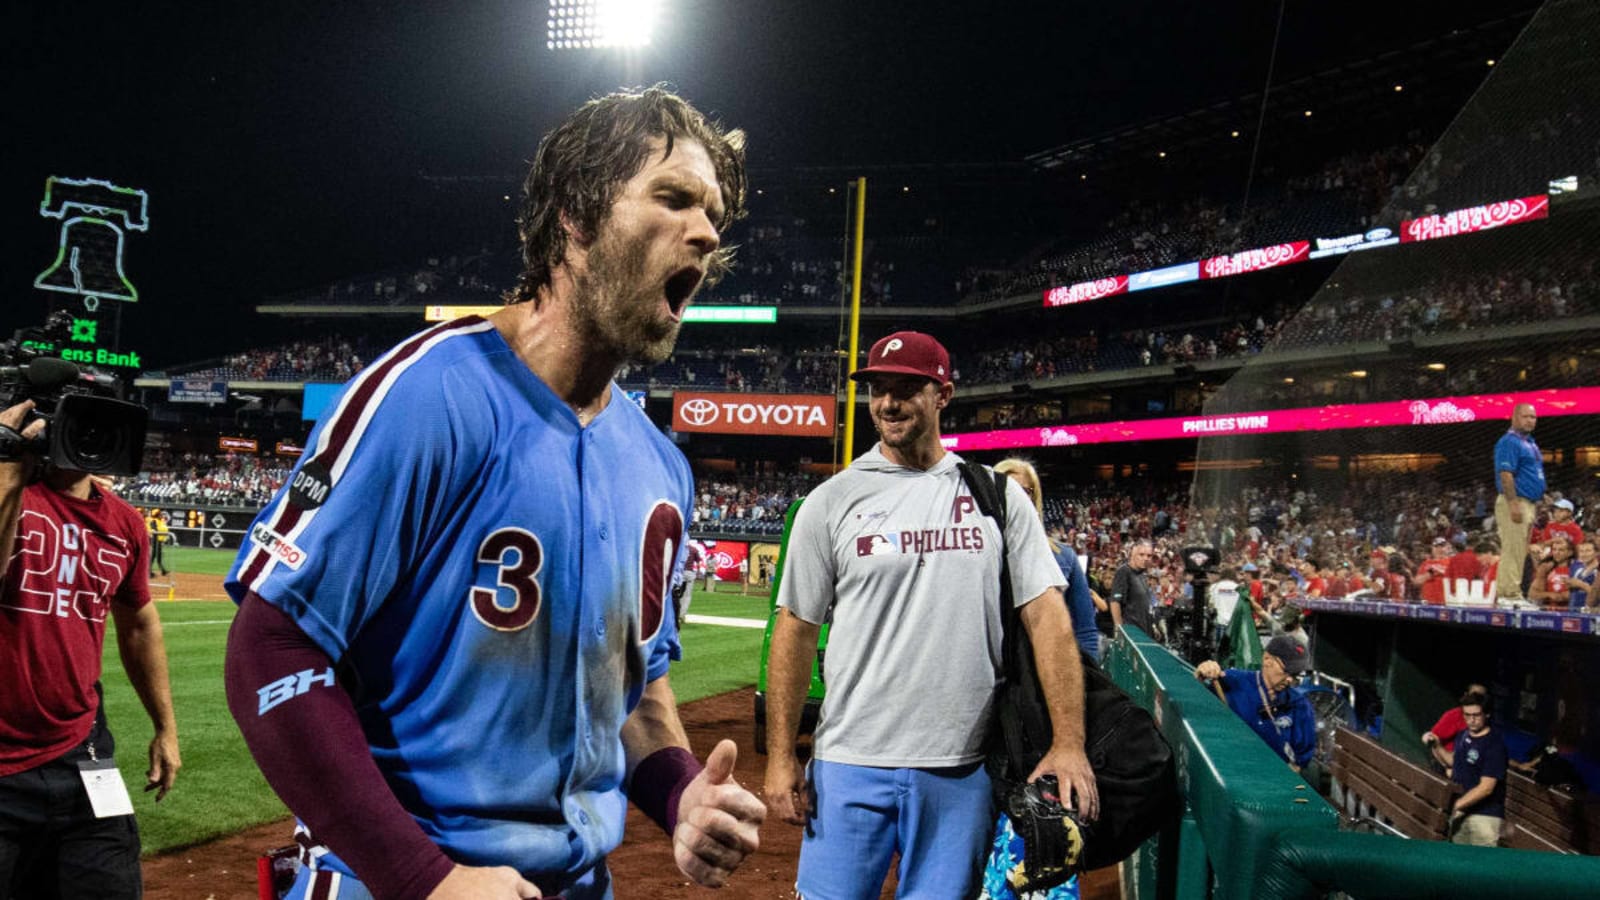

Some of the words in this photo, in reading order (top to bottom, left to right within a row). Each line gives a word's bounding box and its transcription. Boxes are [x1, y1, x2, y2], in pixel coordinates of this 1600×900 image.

[96, 348, 140, 369] Bank
[881, 338, 903, 358] P
[722, 403, 827, 426] TOYOTA
[1183, 417, 1235, 433] PHILLIES
[1237, 414, 1269, 430] WIN!
[293, 471, 328, 503] DPM
[954, 495, 975, 524] P
[900, 526, 984, 554] PHILLIES
[55, 523, 80, 618] ONE
[469, 526, 544, 632] 3
[256, 667, 335, 716] BH
